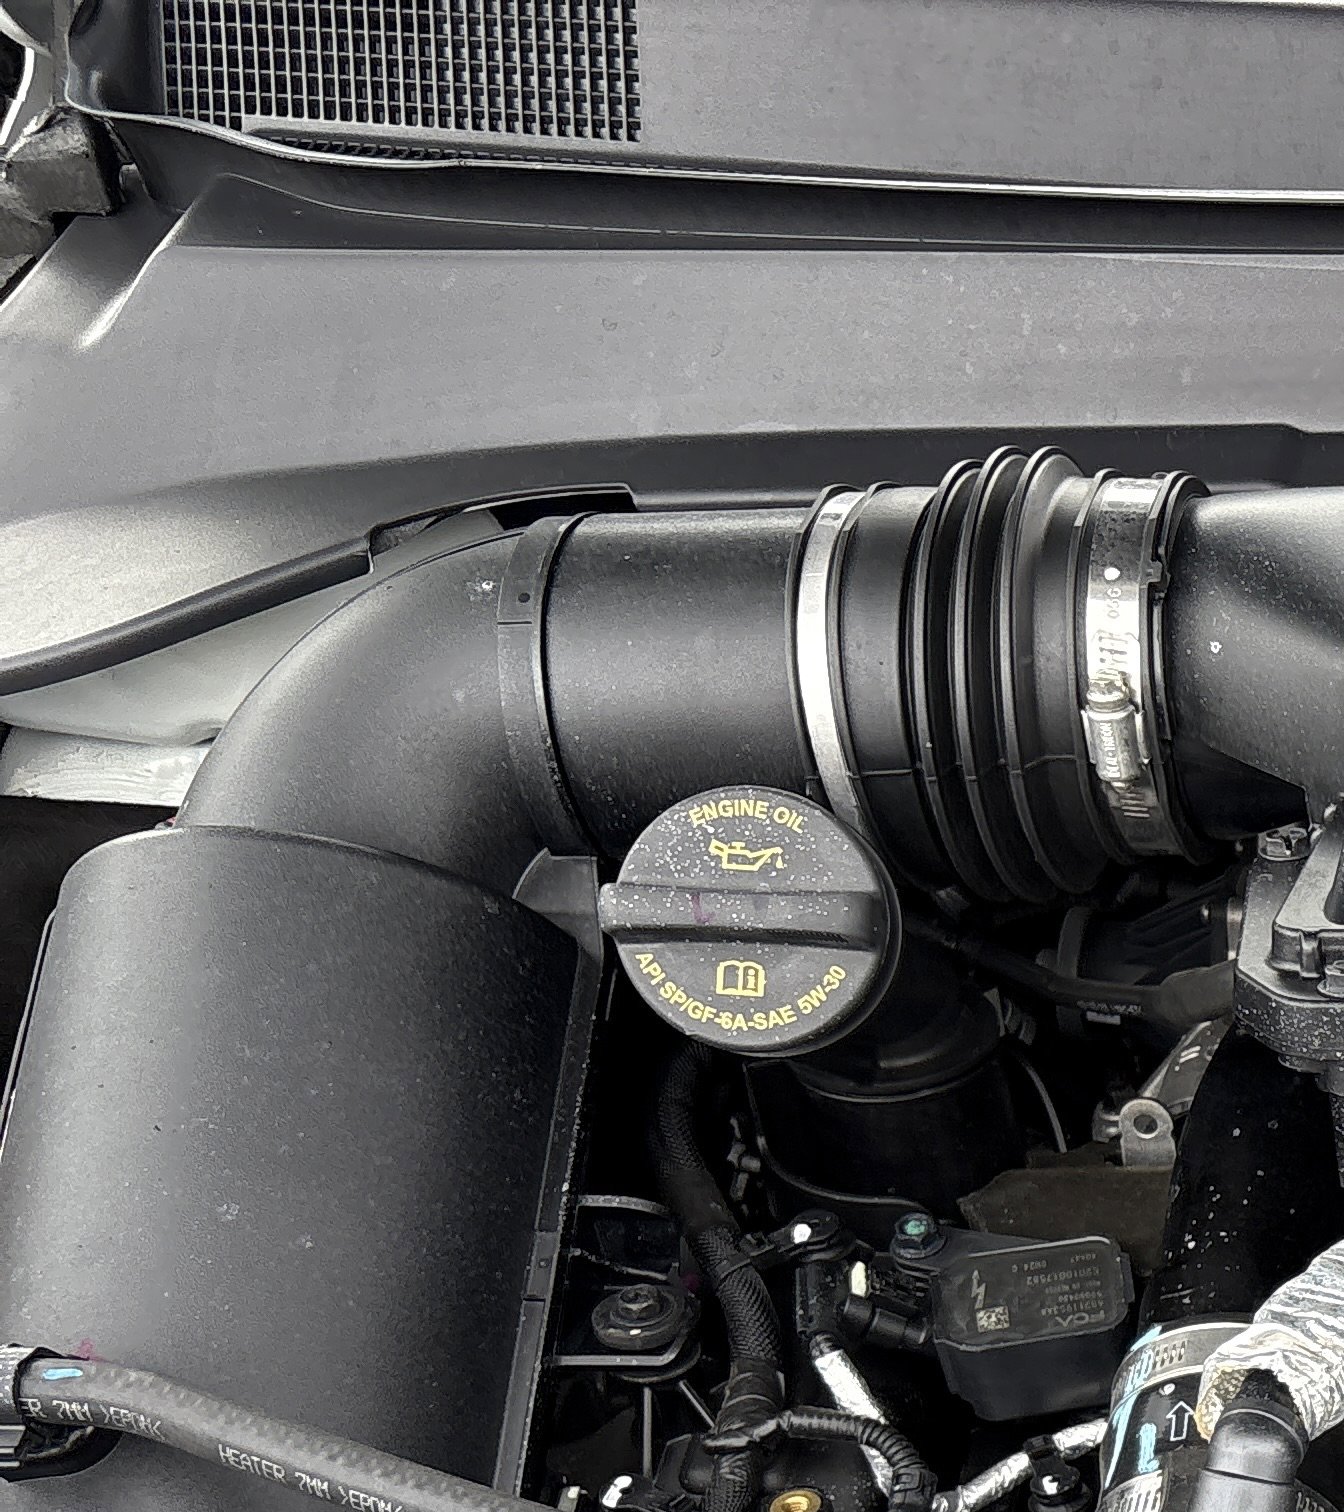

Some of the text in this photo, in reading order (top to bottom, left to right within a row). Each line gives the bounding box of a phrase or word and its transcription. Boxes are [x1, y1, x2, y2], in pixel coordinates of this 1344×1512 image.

[688, 799, 806, 833] ENGINE OIL
[635, 952, 846, 1031] API SP/GF-6A-SAE 5W-30
[218, 1444, 289, 1486] HEATER
[295, 1472, 331, 1500] 7MM
